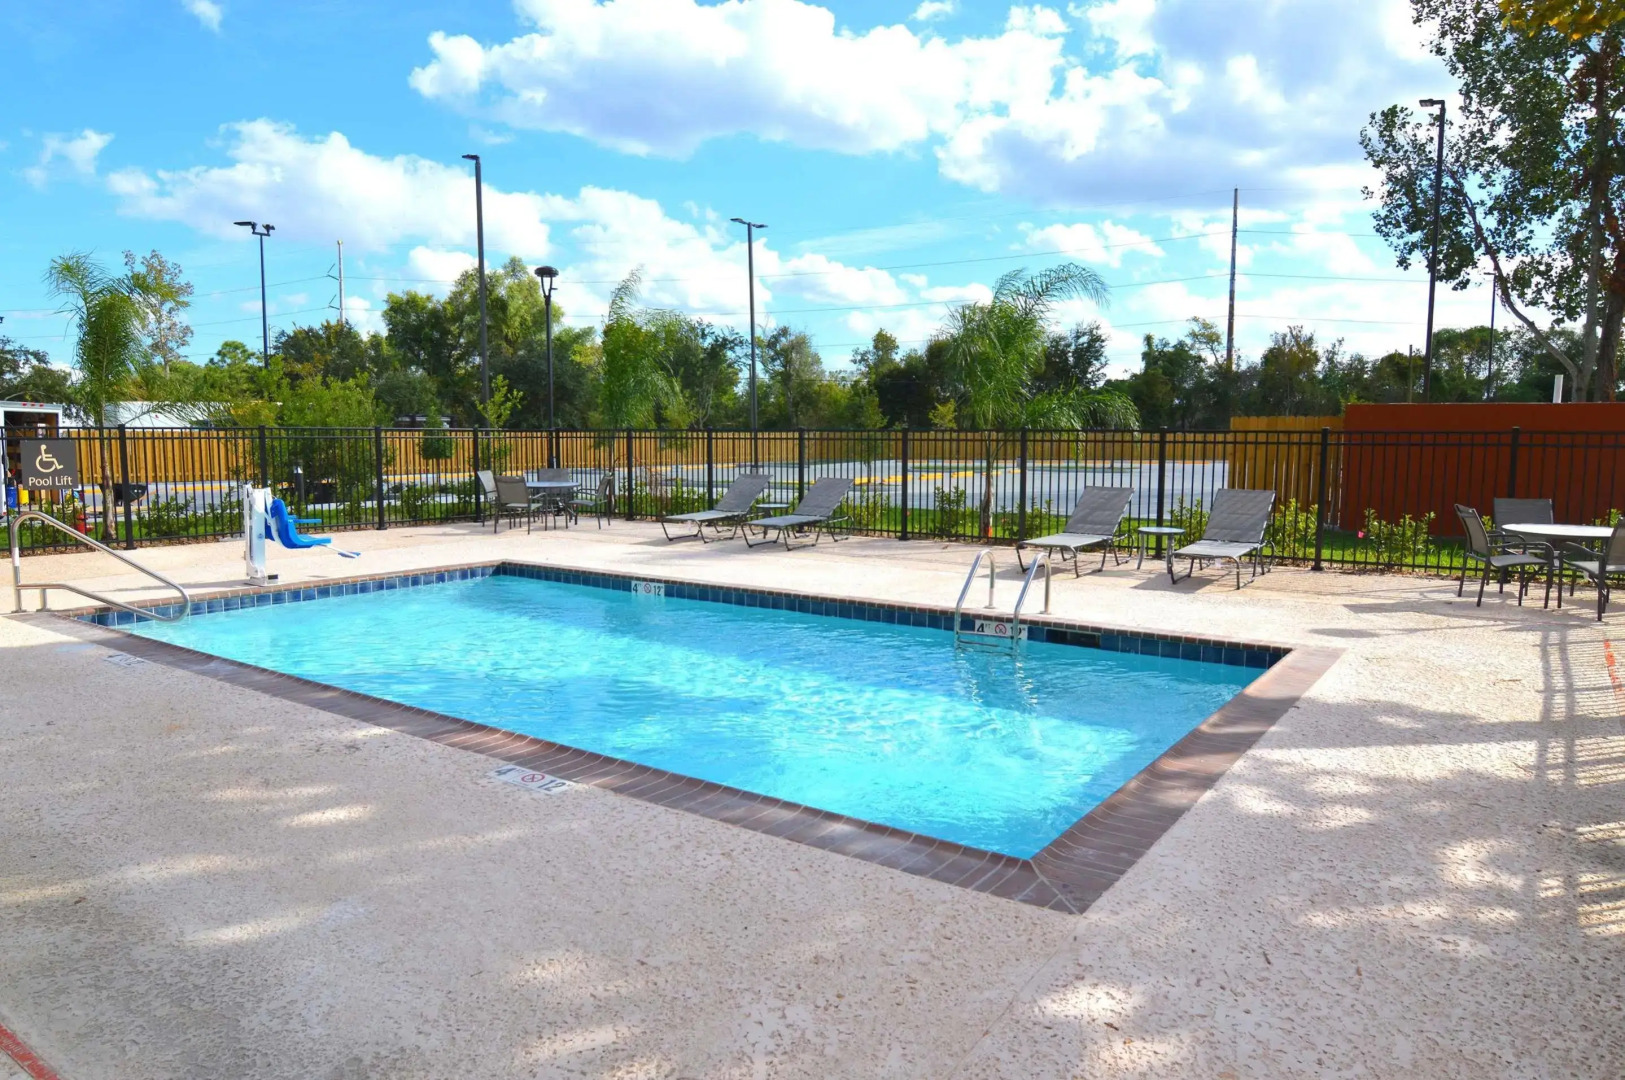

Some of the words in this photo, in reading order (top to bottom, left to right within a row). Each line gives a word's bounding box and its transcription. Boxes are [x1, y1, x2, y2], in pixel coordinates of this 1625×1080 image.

[28, 476, 52, 487] Pool
[55, 475, 72, 486] Lift
[653, 585, 662, 597] 12
